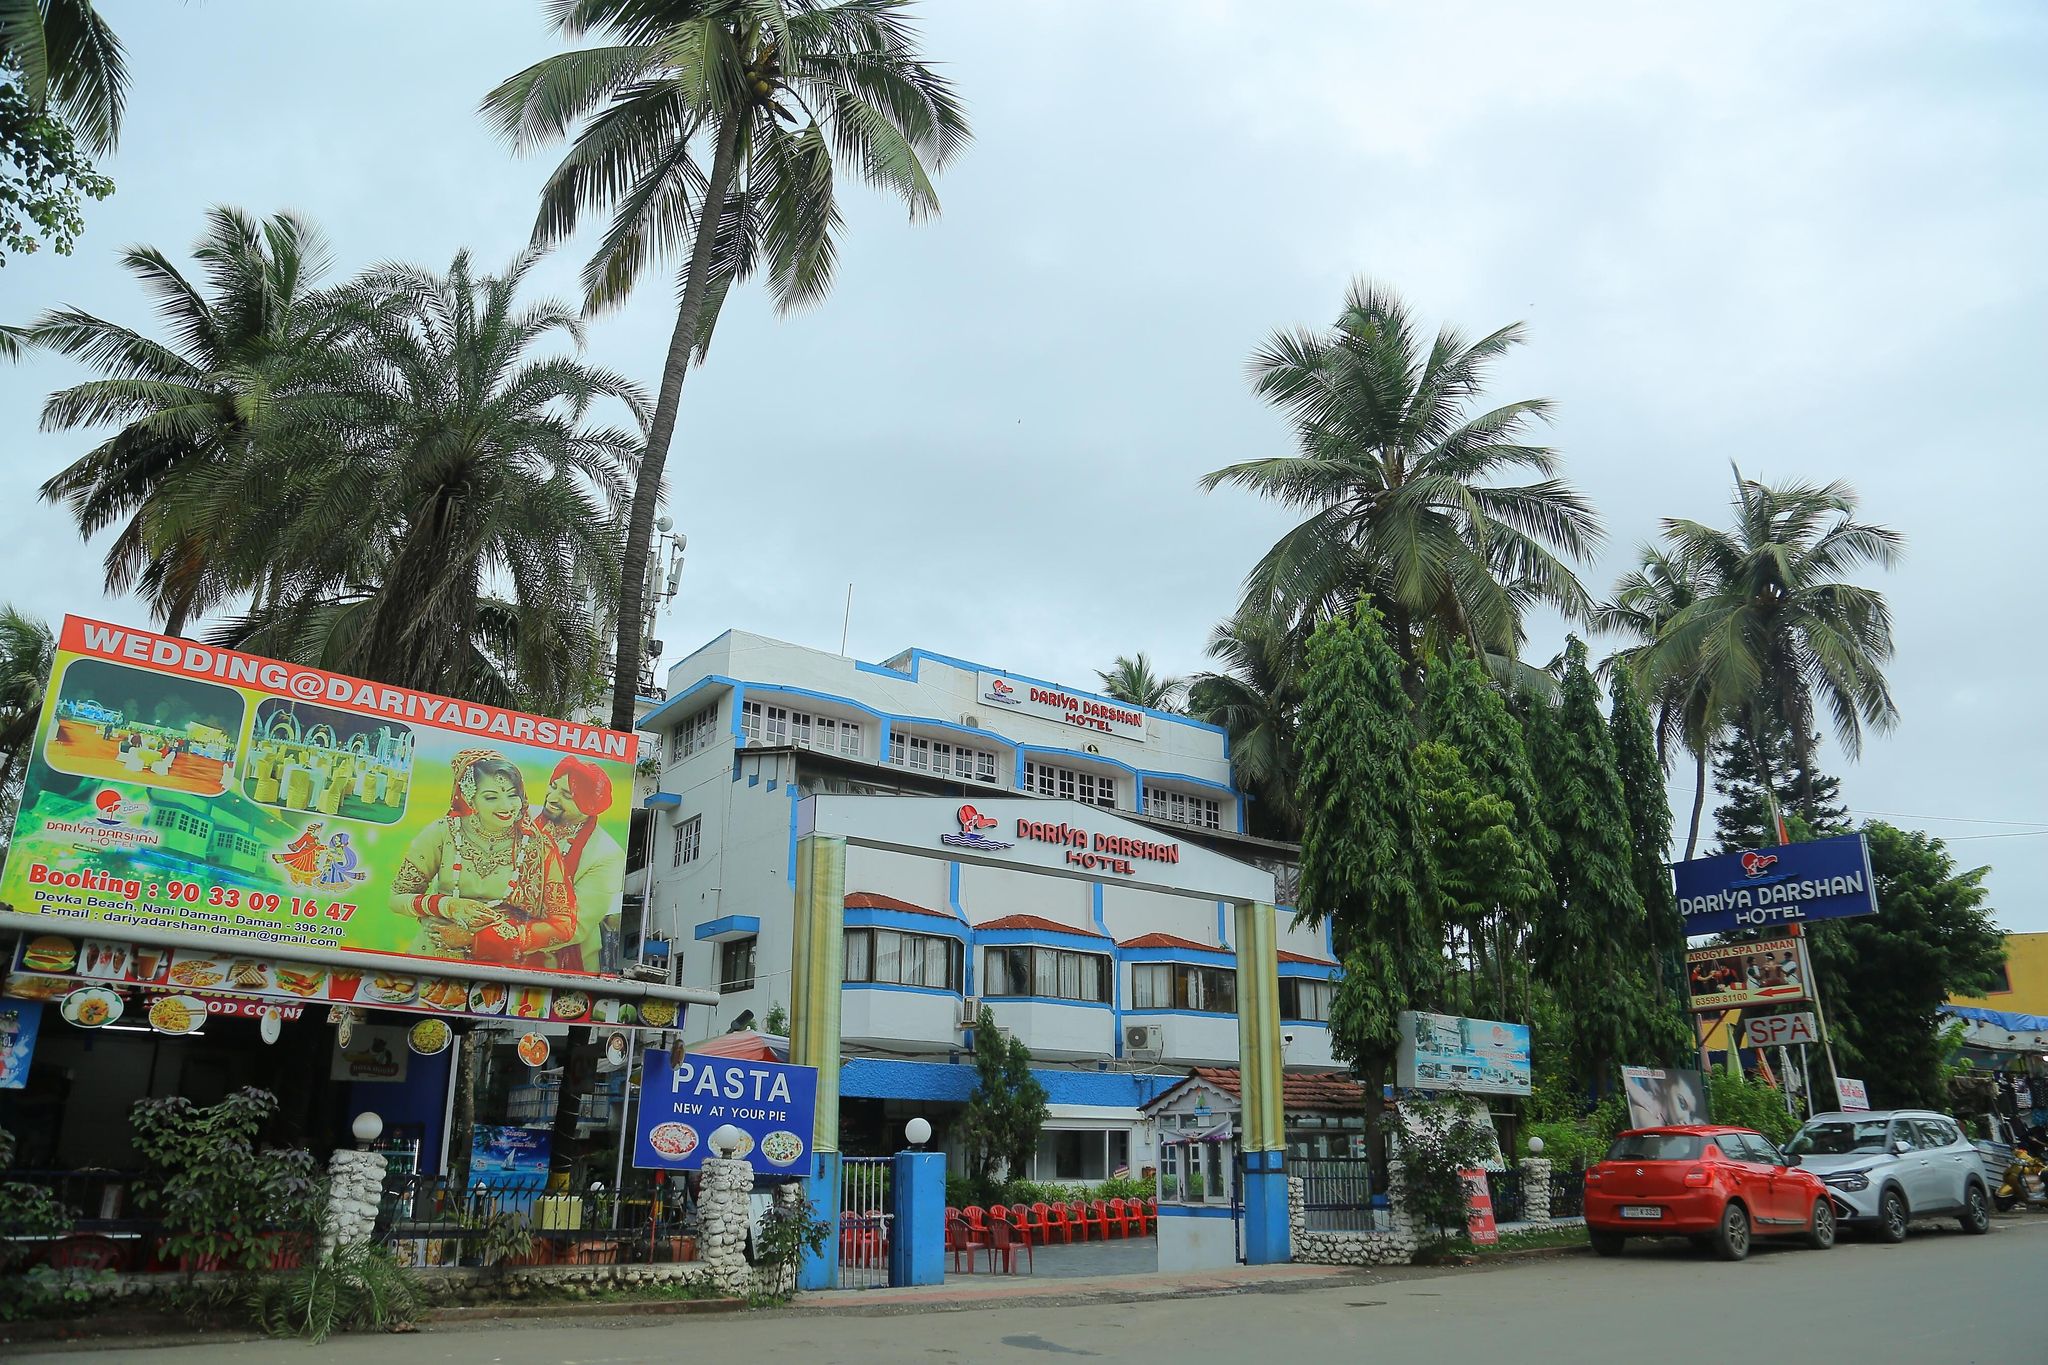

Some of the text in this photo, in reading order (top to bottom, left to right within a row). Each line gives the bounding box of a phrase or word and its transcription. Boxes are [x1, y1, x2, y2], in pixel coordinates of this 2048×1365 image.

[82, 624, 627, 757] WEDDING@DARIYADARSHAN
[1030, 687, 1143, 728] DARIYA DARSHAN
[1065, 712, 1113, 733] HOTEL
[46, 821, 159, 845] DARIYA DARSHAN
[90, 838, 135, 848] HOTEL
[1016, 817, 1180, 864] DARIYA DARSHAN
[1066, 850, 1136, 875] HOTEL
[28, 863, 141, 900] Booking
[167, 880, 200, 904] 90
[208, 886, 241, 909] 33
[248, 892, 280, 914] 09
[291, 897, 319, 919] 16
[325, 902, 358, 923] 47
[1680, 870, 1864, 916] DARIYA DARSHAN
[34, 890, 83, 905] Devka
[87, 896, 138, 913] Beach,
[142, 902, 175, 917] Nani
[179, 907, 231, 924] Daman,
[235, 914, 283, 930] Daman
[294, 921, 317, 934] 396
[40, 904, 90, 919] E-mail
[103, 911, 338, 948] dariyadarshan.daman@gmail.com
[1735, 904, 1806, 925] HOTEL
[1688, 939, 1795, 962] AROGYA SPA DAMAN
[1750, 1015, 1812, 1044] SPA
[671, 1062, 792, 1104] PASTA
[673, 1102, 787, 1122] NEW AT YOUR PIE
